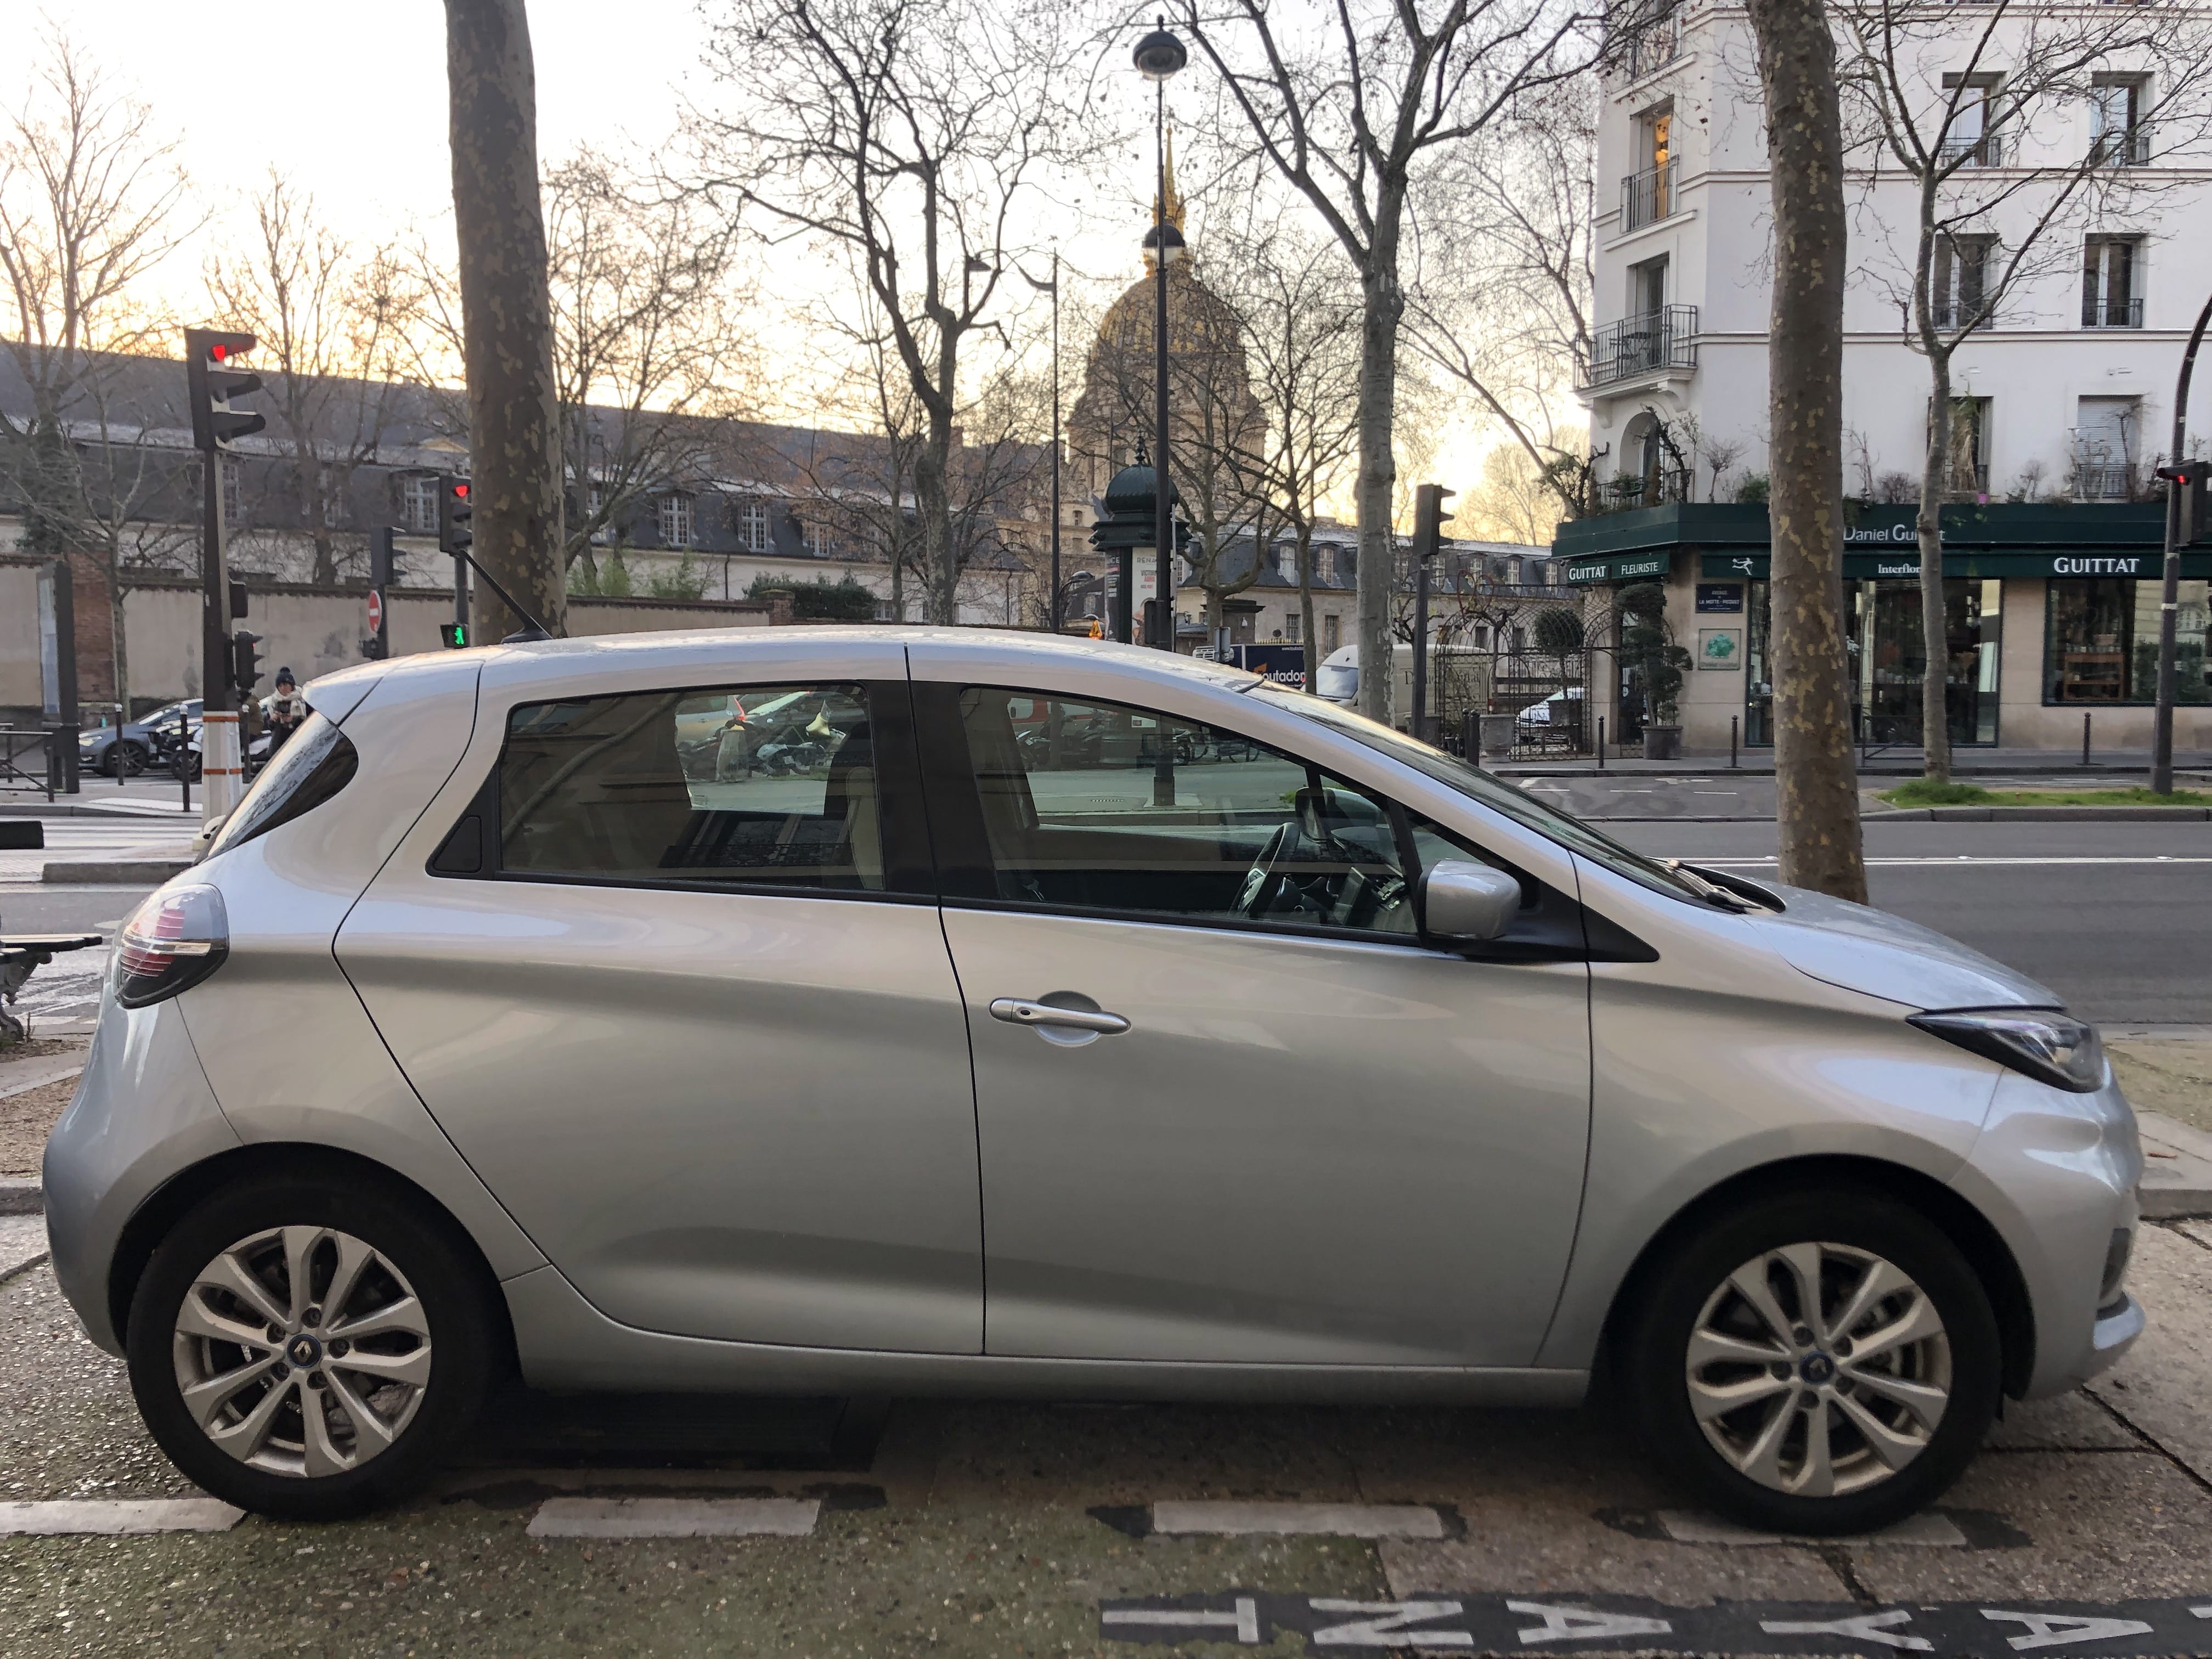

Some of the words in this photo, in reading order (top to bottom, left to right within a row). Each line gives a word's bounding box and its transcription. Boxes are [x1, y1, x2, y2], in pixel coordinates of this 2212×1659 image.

[1843, 527, 1888, 541] Daniel
[1893, 524, 1946, 541] Guit
[1621, 562, 1658, 575] FLEURISTE
[1878, 563, 1921, 574] Interflor
[2053, 557, 2140, 573] GUITTAT
[1568, 566, 1606, 580] GUITTAT
[1102, 1596, 2212, 1651] AYANT
